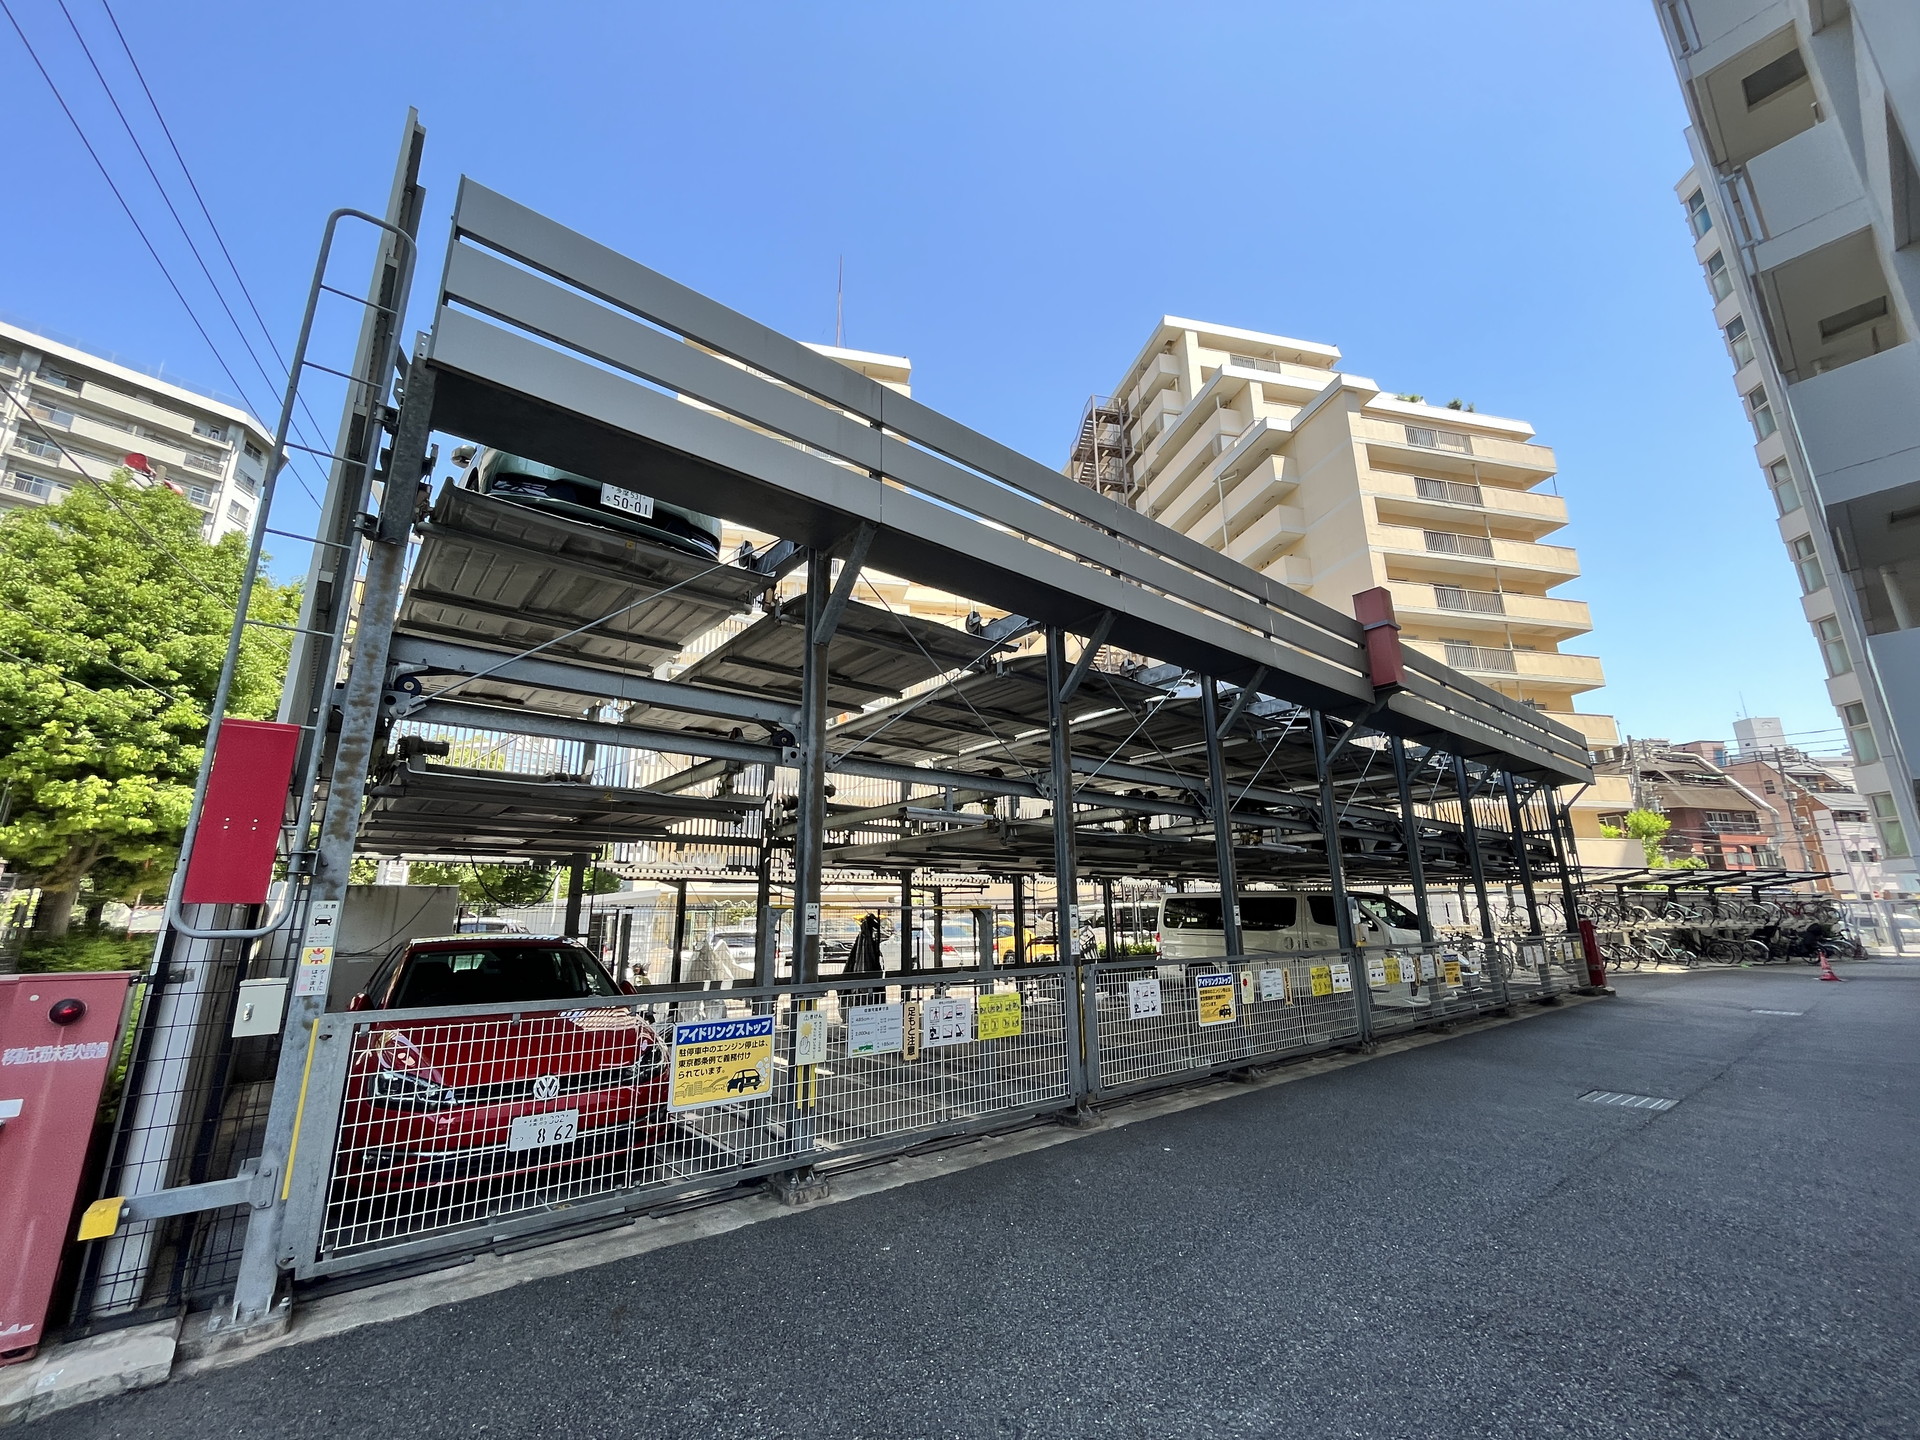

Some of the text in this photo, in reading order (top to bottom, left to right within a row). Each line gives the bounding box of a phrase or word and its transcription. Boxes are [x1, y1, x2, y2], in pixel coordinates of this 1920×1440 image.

[613, 494, 648, 515] 50-01
[678, 1020, 771, 1043] アイドリングストップ
[2, 1041, 109, 1066] 移動式粉末消火設備
[679, 1040, 769, 1057] 駐停車中のエンジン停止は、
[678, 1052, 752, 1069] 東京都条例で義務付け
[678, 1066, 726, 1080] られています。
